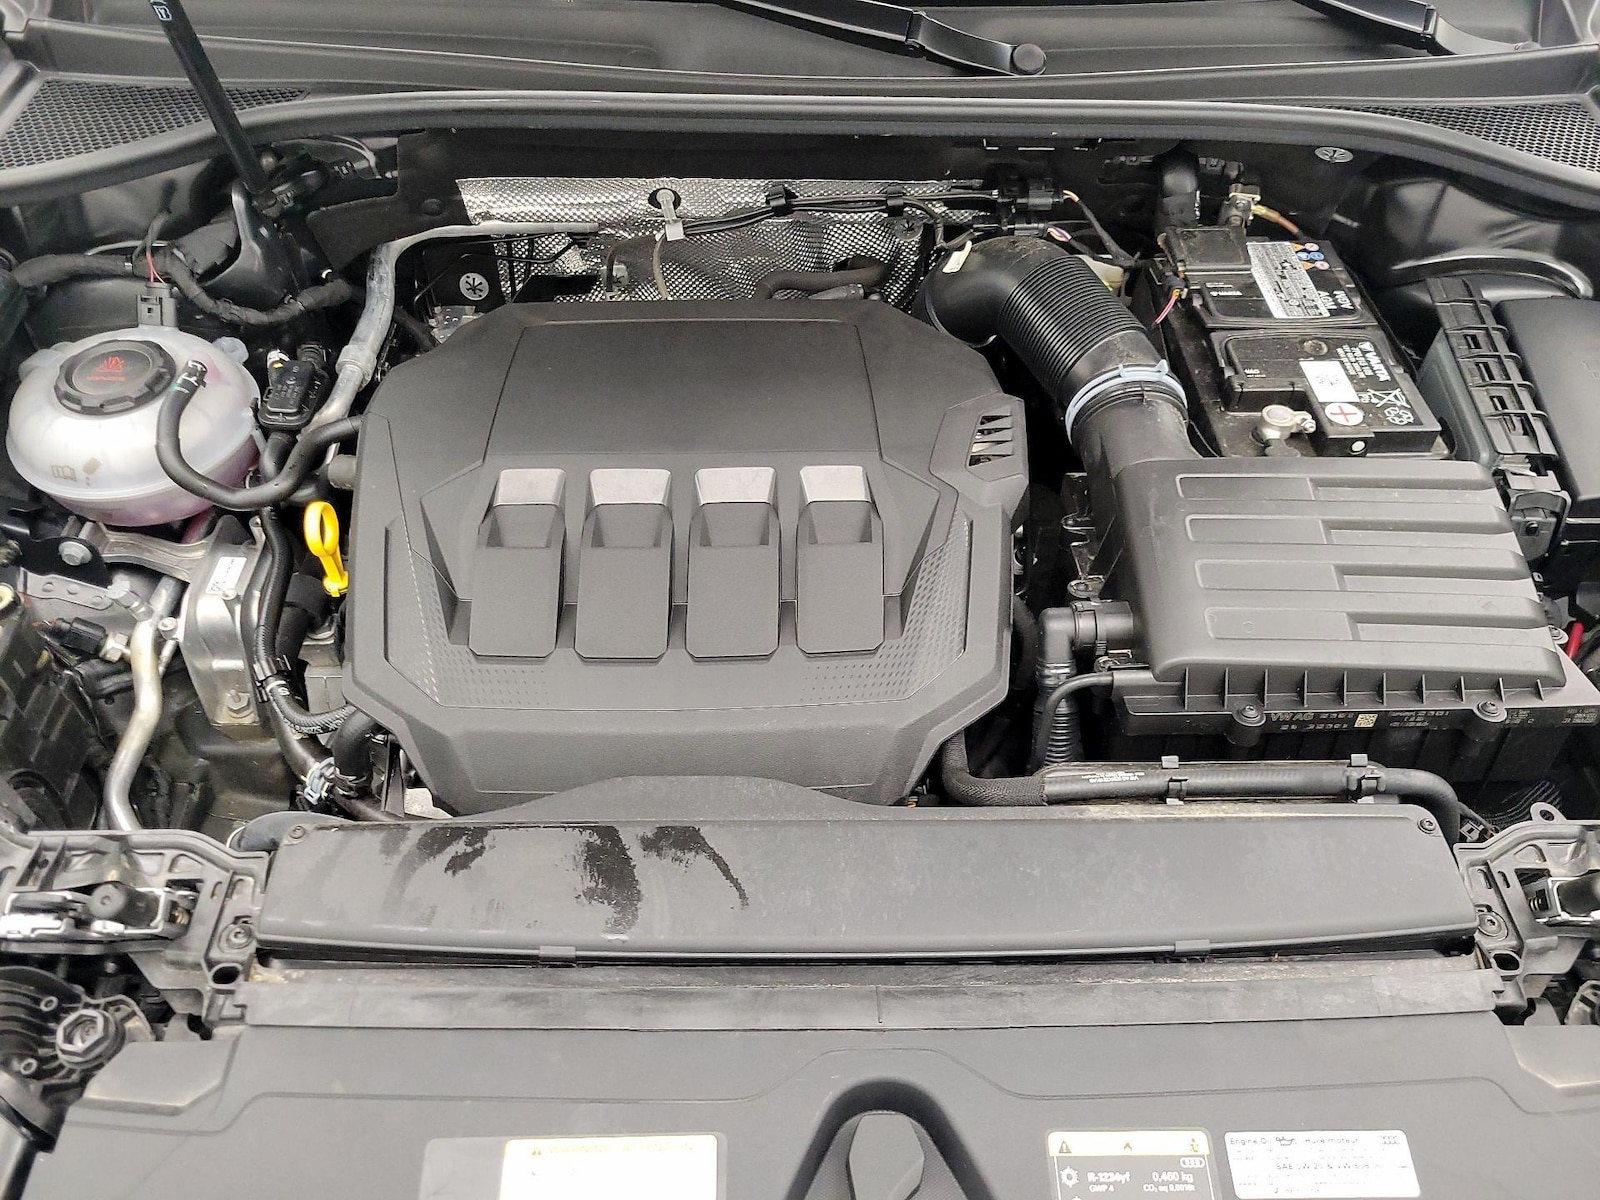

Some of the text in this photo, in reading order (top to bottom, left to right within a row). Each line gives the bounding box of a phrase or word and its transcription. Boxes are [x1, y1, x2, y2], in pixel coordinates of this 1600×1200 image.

[1317, 291, 1338, 309] AGM
[1364, 351, 1391, 381] VARTA
[1230, 1137, 1258, 1145] Engine
[1181, 1171, 1194, 1183] kg
[1089, 1184, 1108, 1193] GWP
